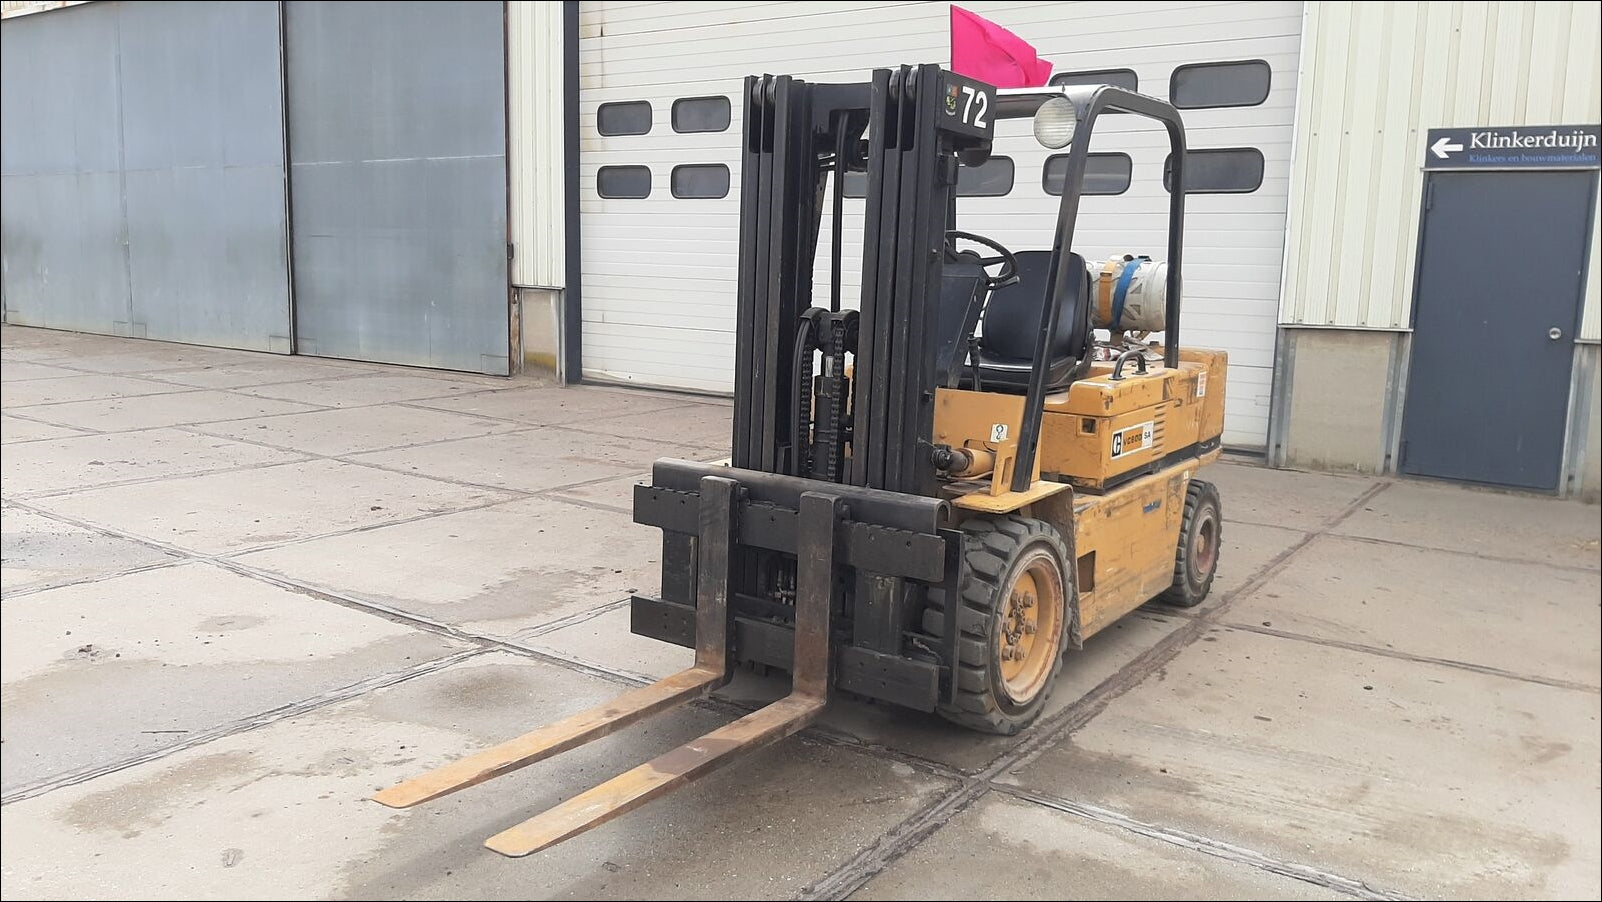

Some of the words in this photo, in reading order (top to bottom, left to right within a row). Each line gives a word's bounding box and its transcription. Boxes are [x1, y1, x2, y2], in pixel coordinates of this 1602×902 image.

[962, 85, 988, 129] 72
[1470, 131, 1597, 152] Klinkerduijn
[1469, 153, 1506, 163] Klinkers
[1508, 155, 1520, 163] en
[1521, 152, 1597, 163] bouwmaterialen
